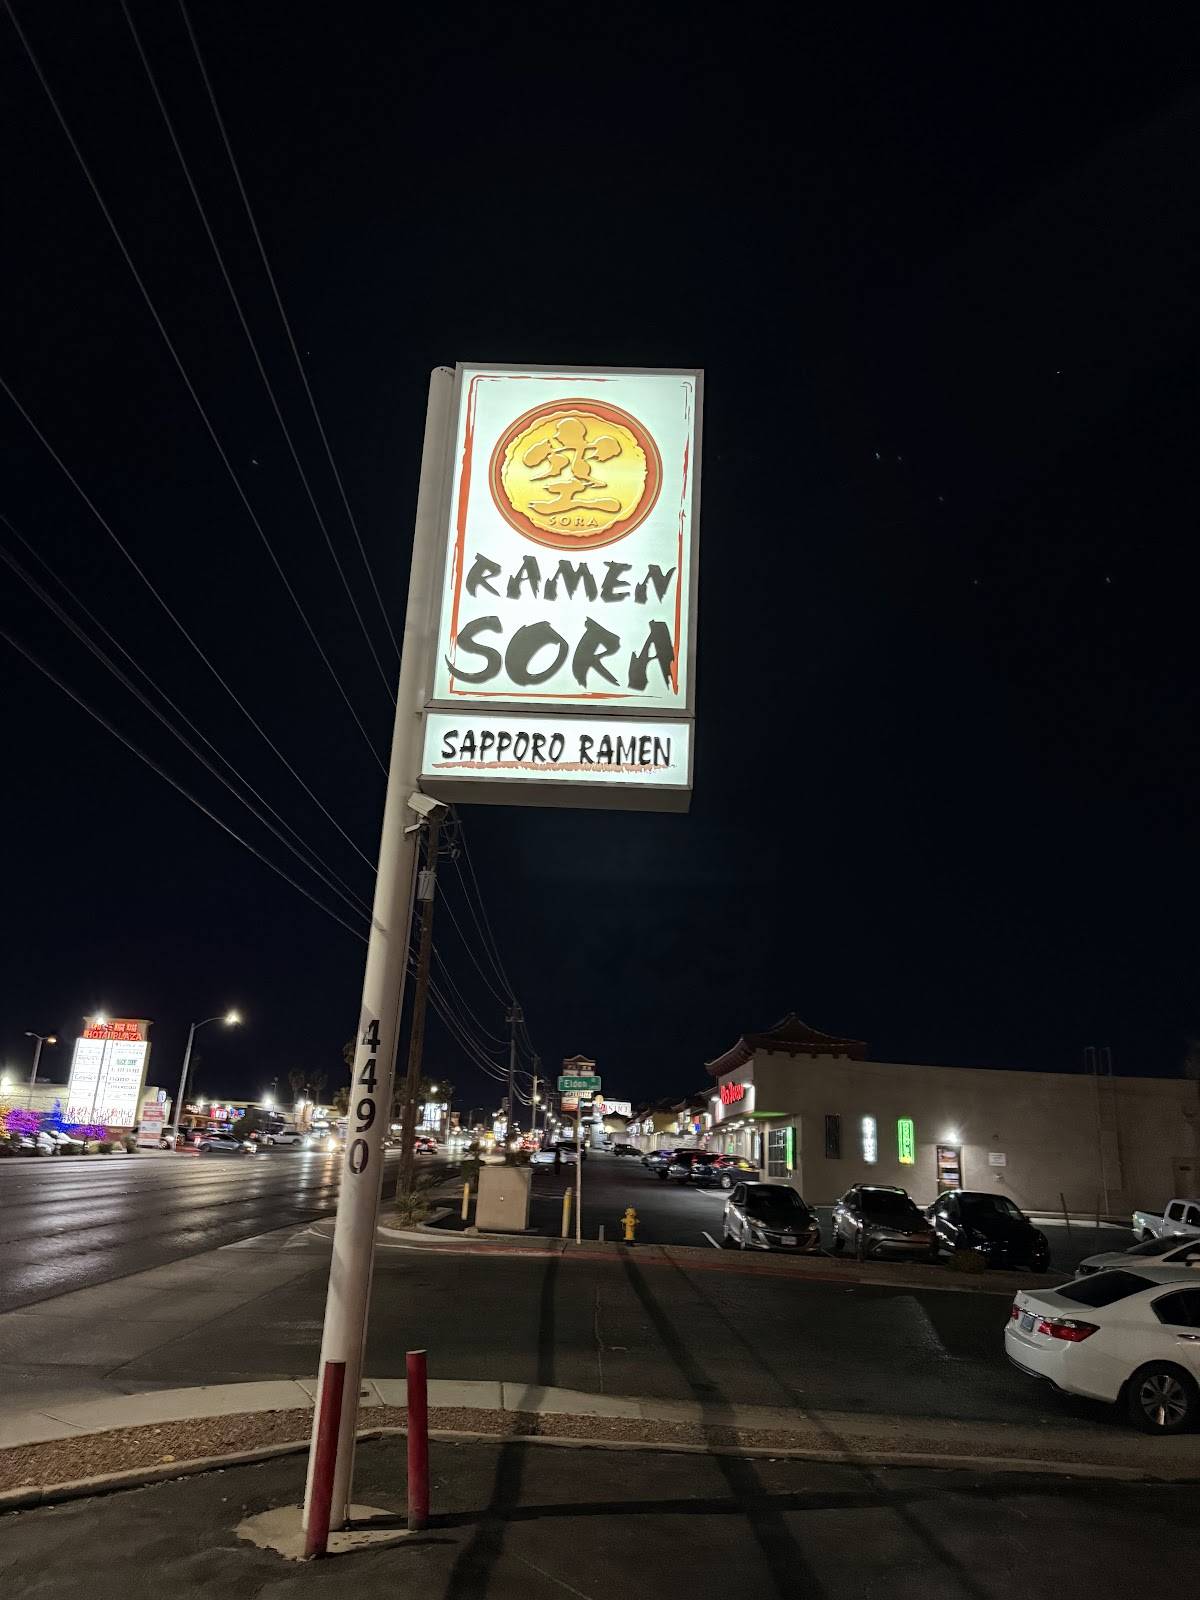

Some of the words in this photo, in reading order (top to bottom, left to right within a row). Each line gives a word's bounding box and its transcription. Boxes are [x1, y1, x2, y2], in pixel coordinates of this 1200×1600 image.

[549, 514, 599, 528] SORA
[465, 552, 677, 604] RAMEN
[445, 615, 676, 692] SORA
[441, 729, 565, 763] SAPPORO
[579, 734, 672, 767] RAMEN
[349, 1019, 381, 1175] 4490
